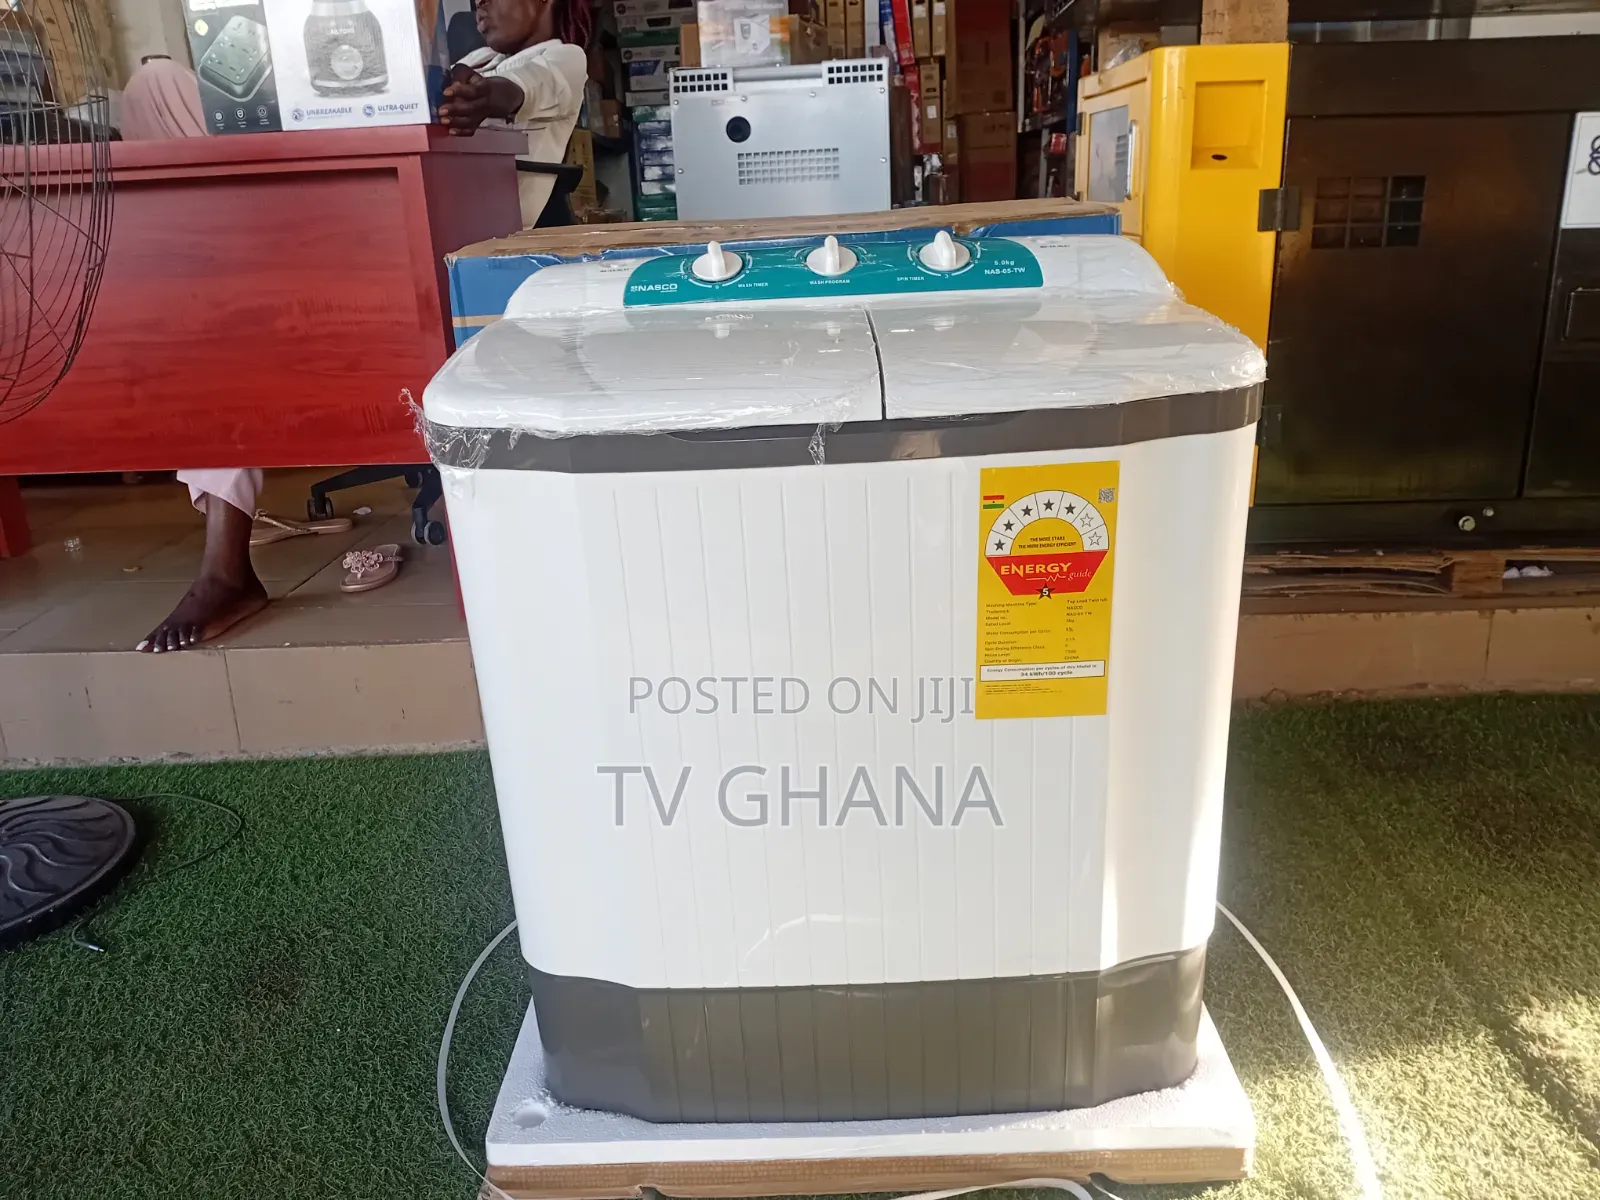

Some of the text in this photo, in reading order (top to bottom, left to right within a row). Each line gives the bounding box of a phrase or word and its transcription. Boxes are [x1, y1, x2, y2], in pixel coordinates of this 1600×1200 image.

[306, 107, 352, 116] UNBREAKABLE
[985, 267, 1026, 275] NAS-05-TW
[638, 284, 678, 292] NASCO
[1000, 562, 1092, 581] ENERGY guide
[1042, 587, 1049, 596] 5
